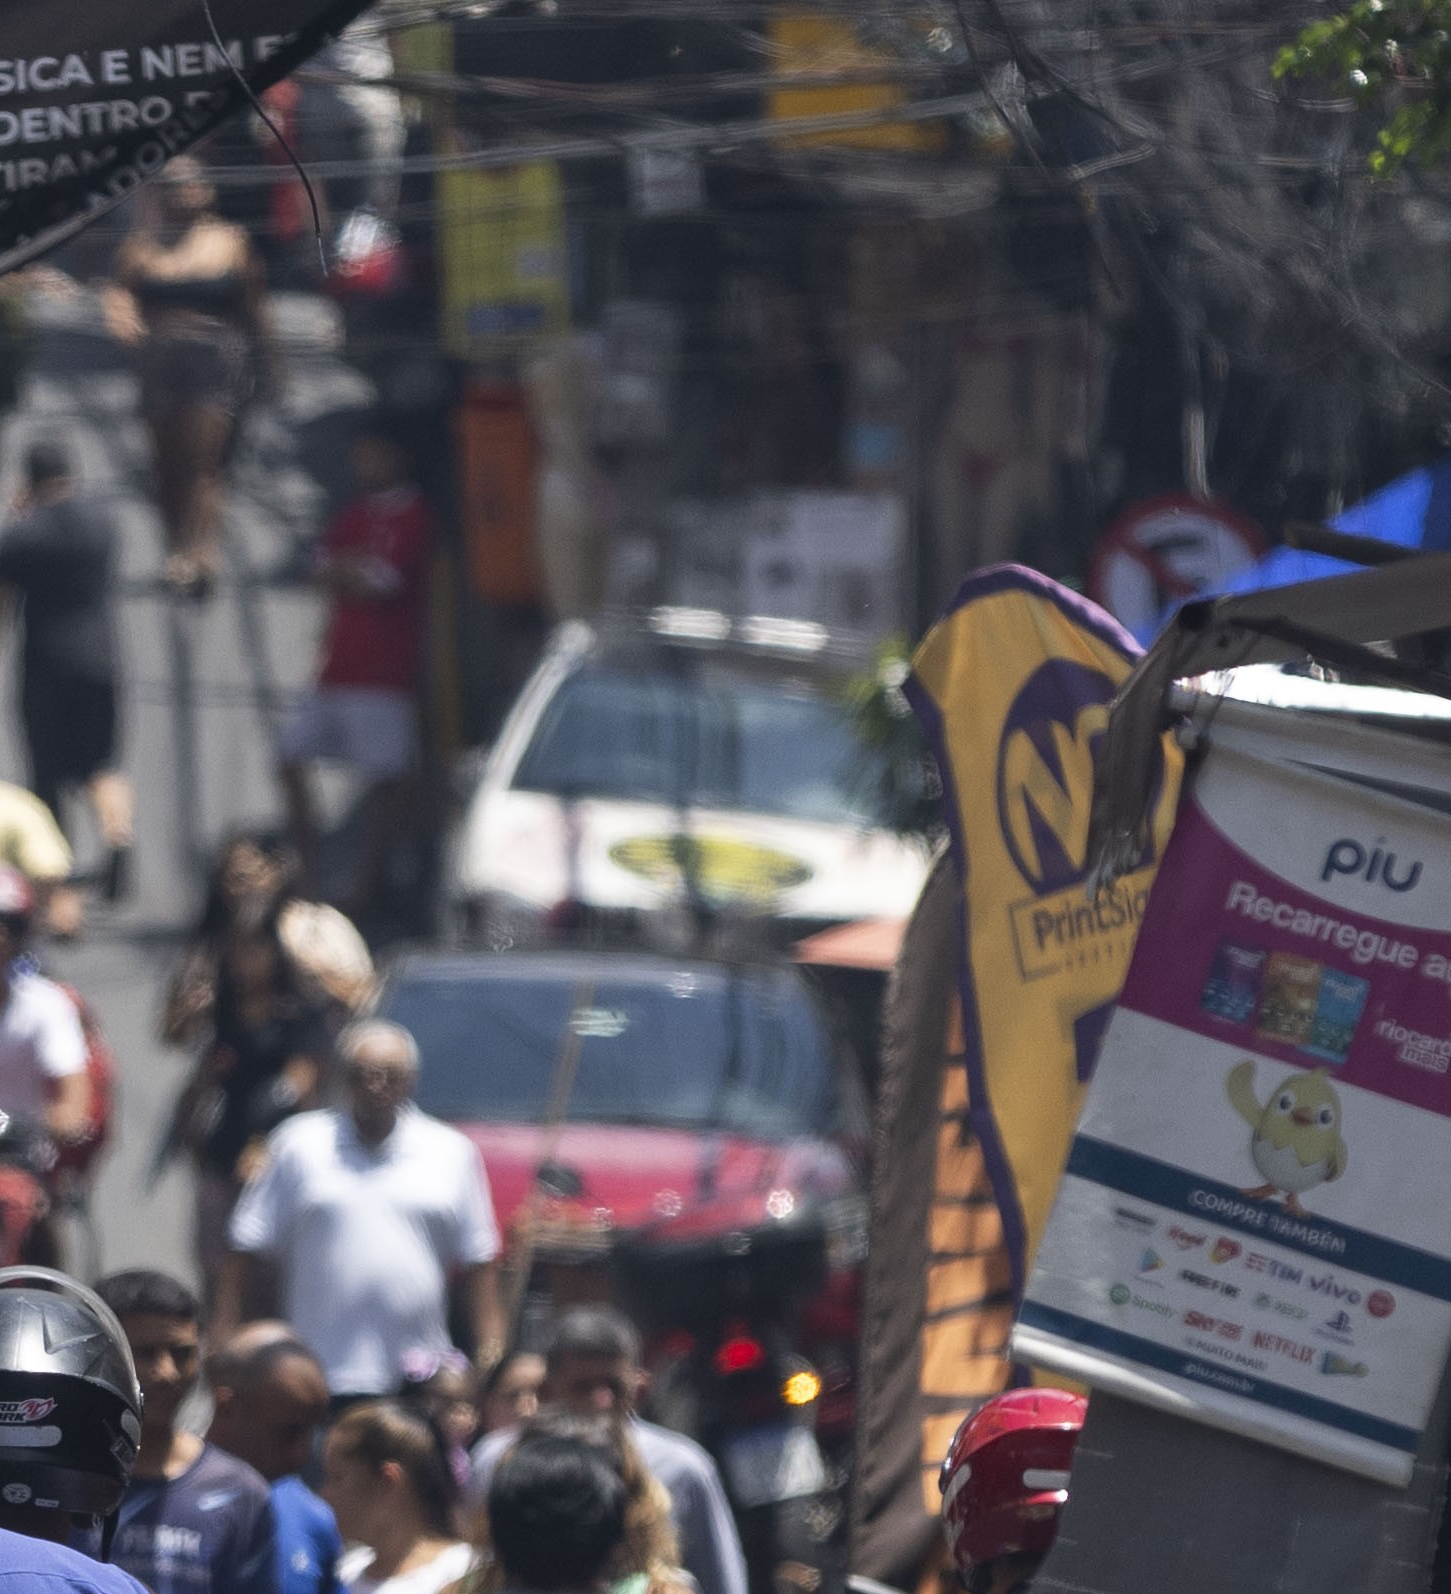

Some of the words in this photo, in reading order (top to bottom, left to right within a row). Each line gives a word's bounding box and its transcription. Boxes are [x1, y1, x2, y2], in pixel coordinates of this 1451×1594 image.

[100, 49, 132, 84] E
[140, 40, 243, 80] NEM
[1321, 836, 1425, 893] piu
[1224, 879, 1420, 969] Recarregue
[1188, 1189, 1269, 1225] COMPRE
[1269, 1215, 1347, 1254] TAMBÉM
[1309, 1275, 1362, 1305] vivo
[1253, 1330, 1317, 1366] NETFLIX
